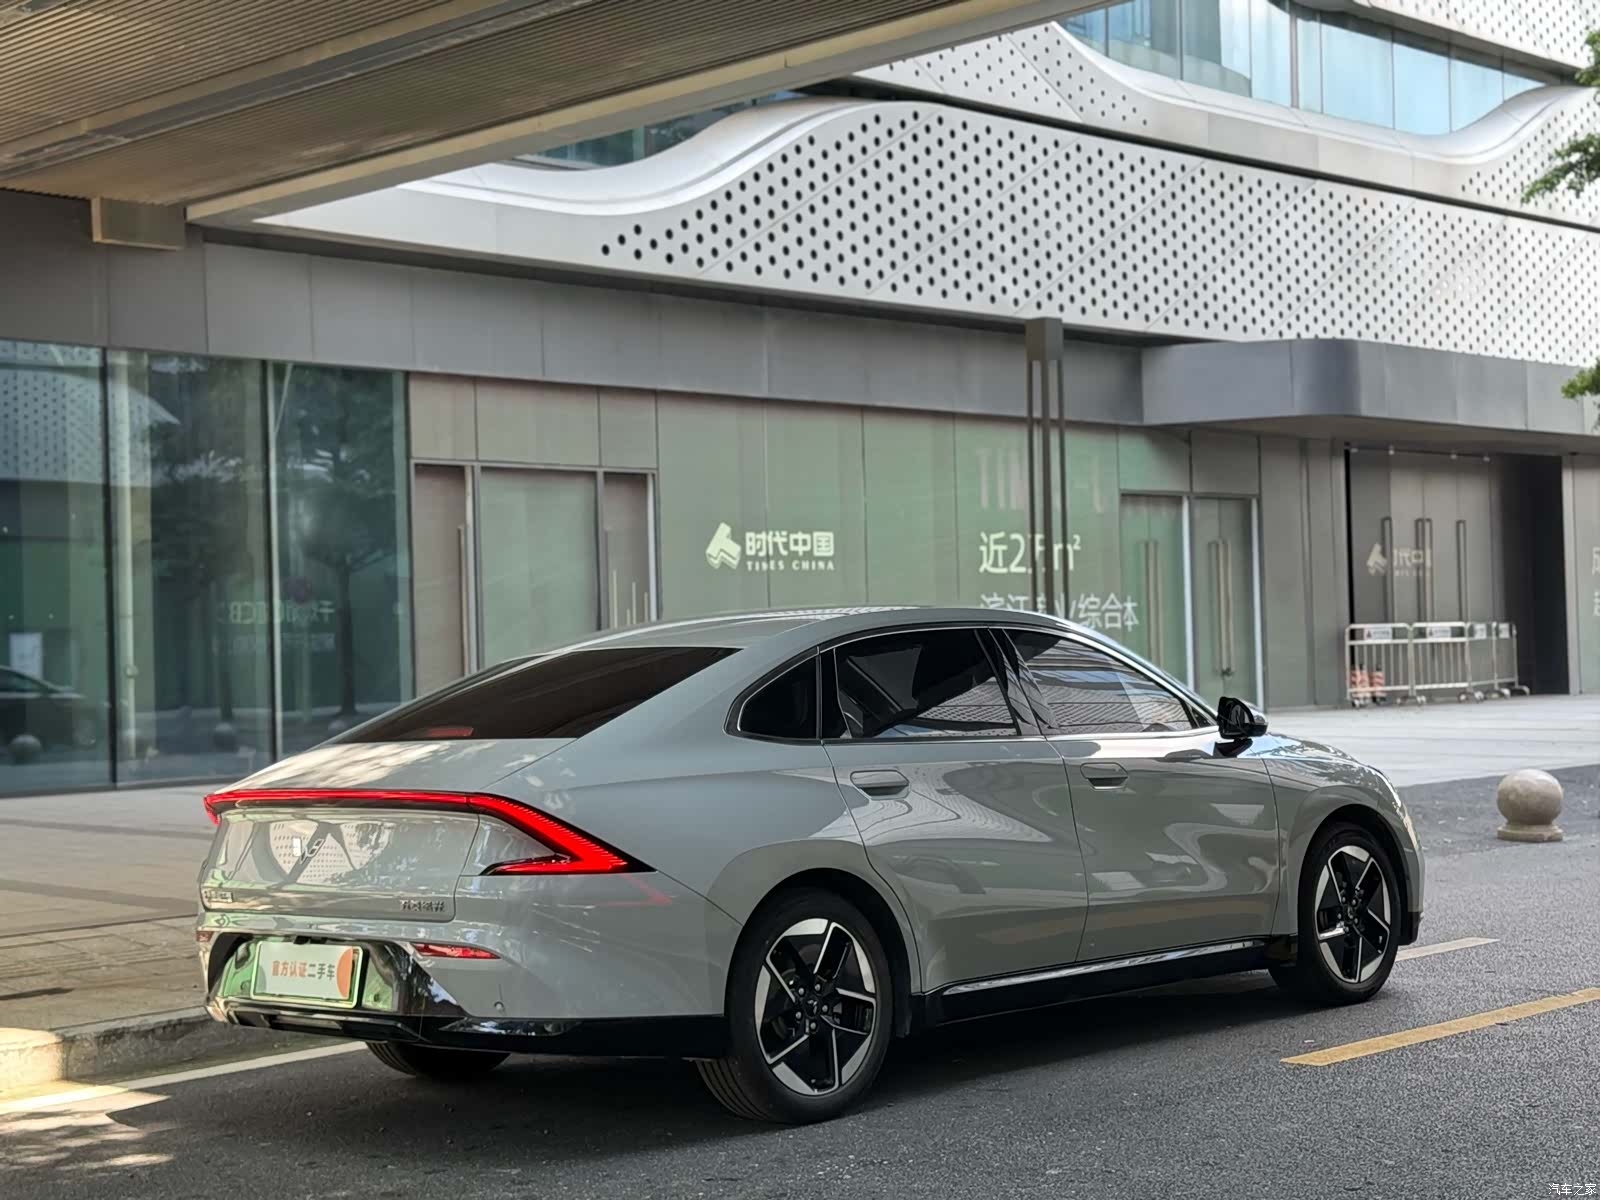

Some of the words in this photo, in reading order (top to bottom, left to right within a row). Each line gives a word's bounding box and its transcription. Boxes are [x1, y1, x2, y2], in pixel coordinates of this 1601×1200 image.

[745, 531, 835, 557] 时代中国
[792, 560, 835, 571] CHINA
[272, 960, 335, 980] 官方认证二手车
